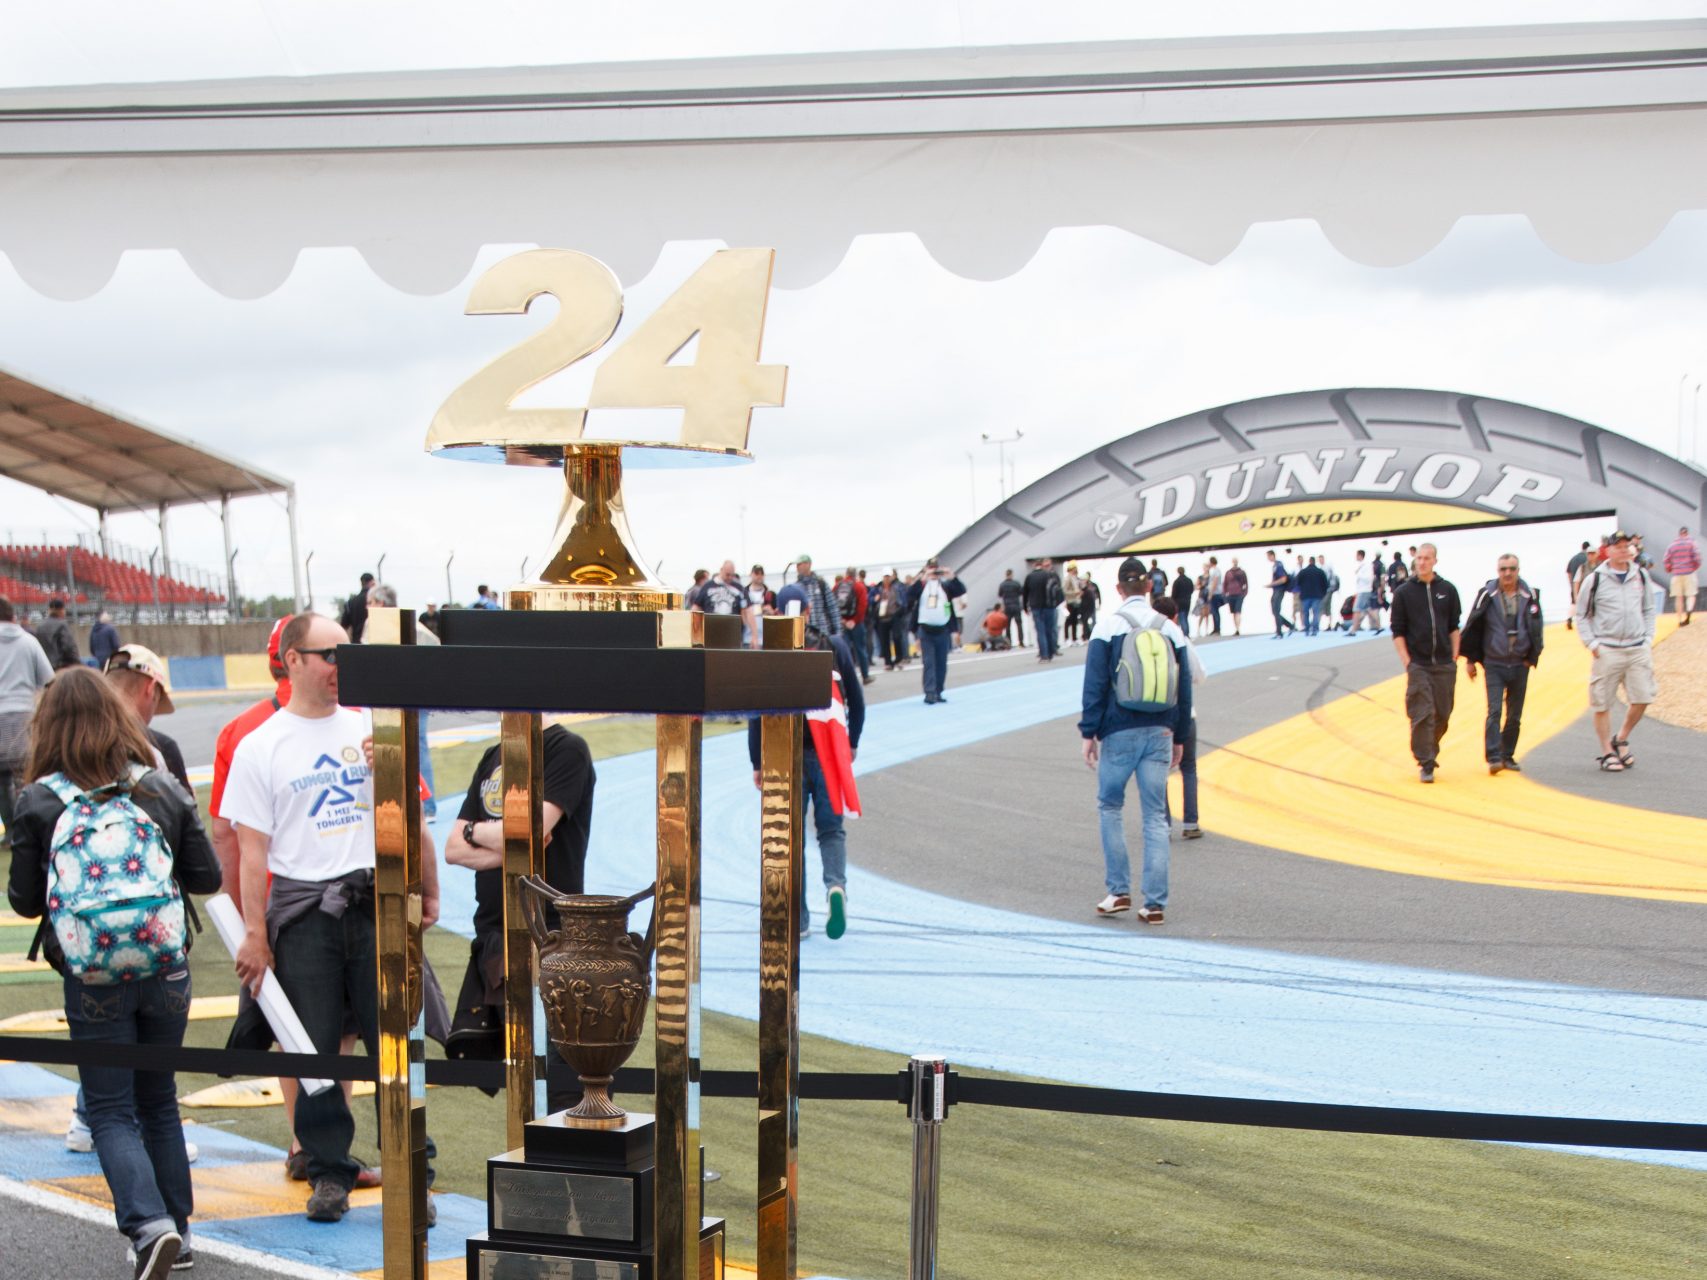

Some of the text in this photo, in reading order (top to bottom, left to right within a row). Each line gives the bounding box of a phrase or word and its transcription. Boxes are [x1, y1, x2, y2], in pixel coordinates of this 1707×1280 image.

[425, 247, 788, 450] 24
[1134, 448, 1564, 536] DUNLOP
[1259, 511, 1361, 529] DUNLOP
[290, 771, 338, 793] TUNGRI
[334, 807, 351, 816] MEI
[316, 814, 363, 830] TONGEREN
